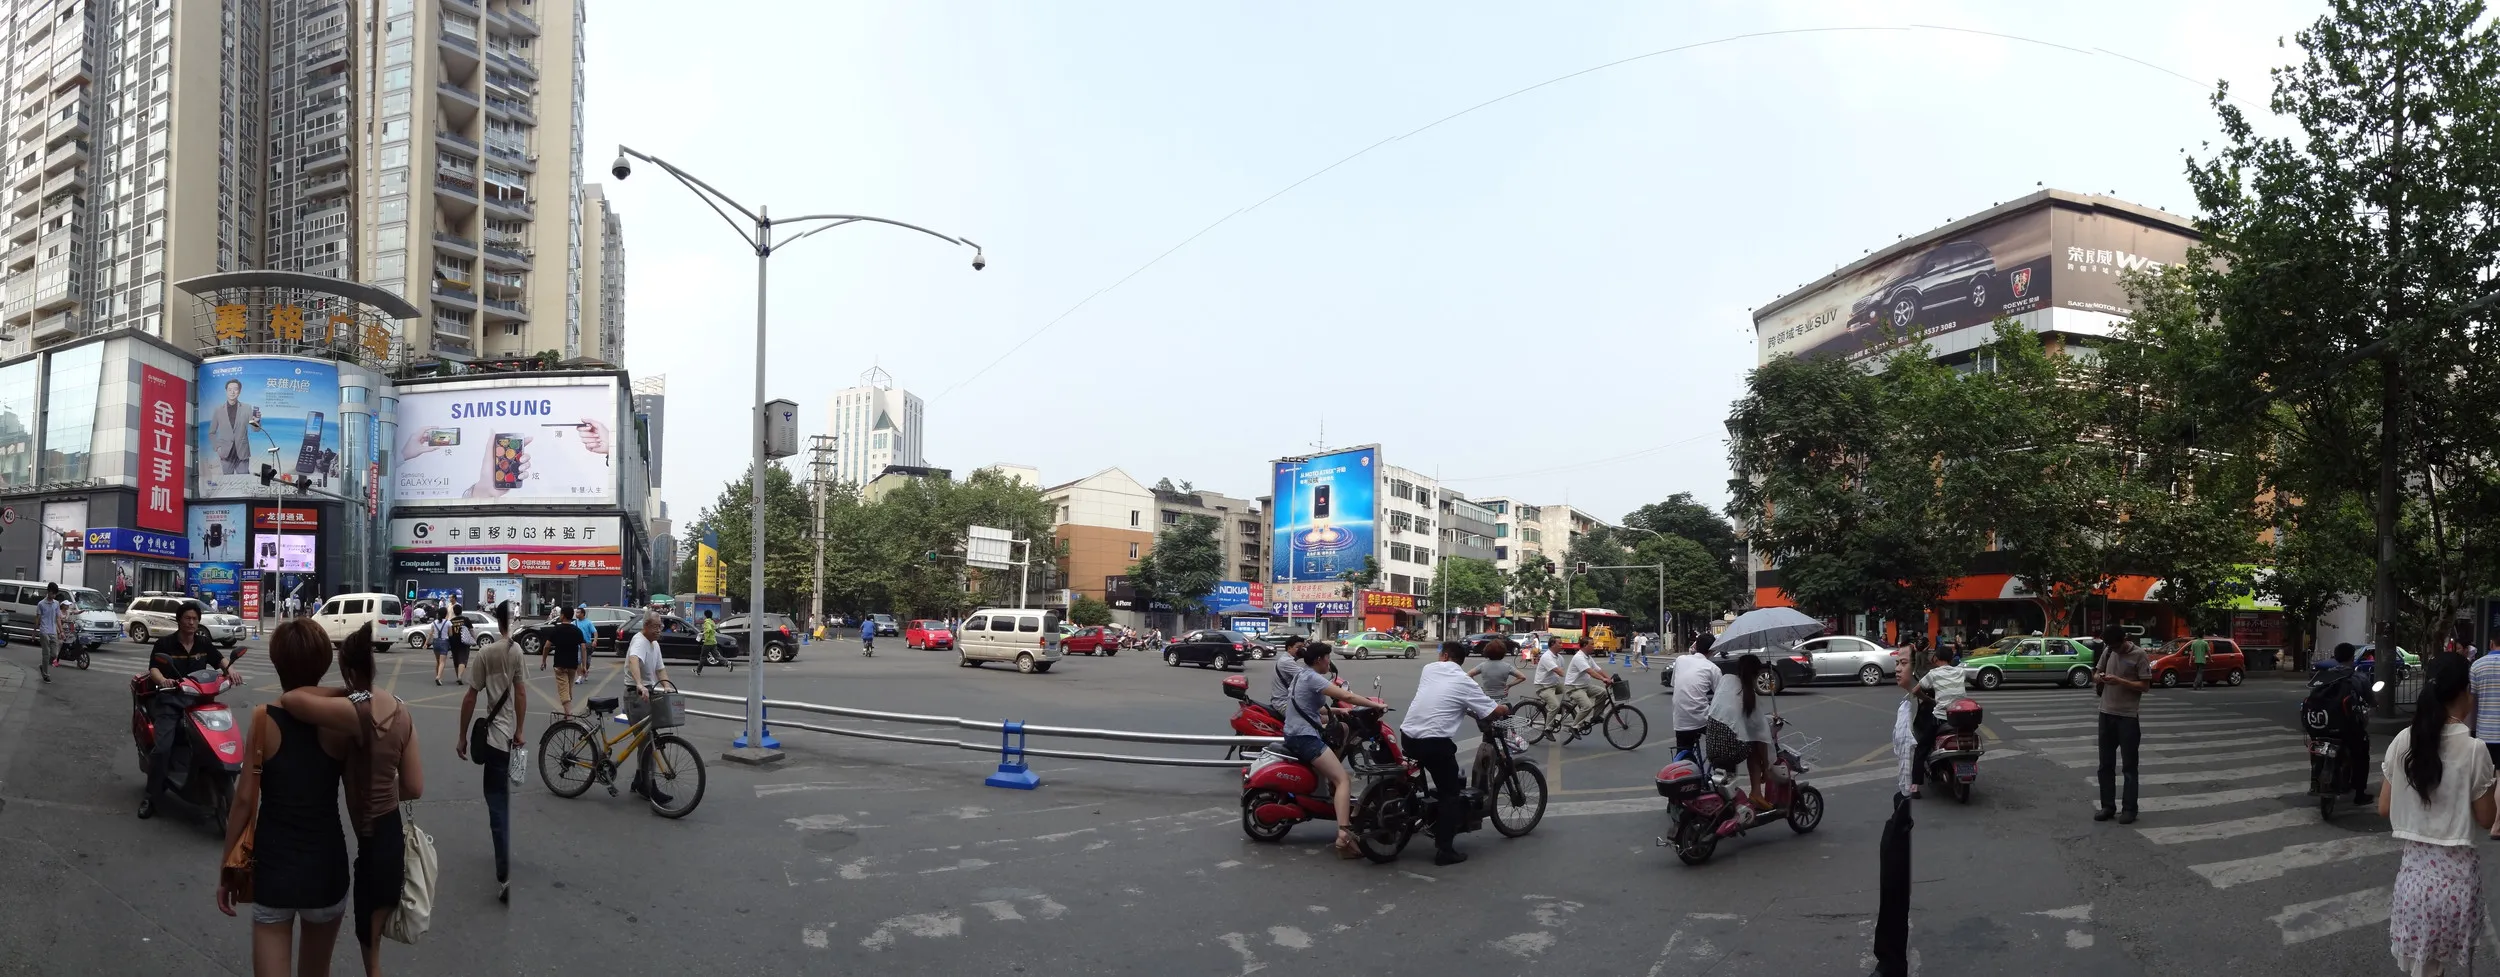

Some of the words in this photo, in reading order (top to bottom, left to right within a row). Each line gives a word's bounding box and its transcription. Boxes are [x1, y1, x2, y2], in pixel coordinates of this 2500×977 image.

[2003, 299, 2028, 310] ROEWE
[1767, 309, 1838, 349] 跨领域专业SUV
[1940, 321, 1957, 331] 3083
[266, 378, 311, 392] 英雄本色
[451, 399, 551, 419] SAMSUNG
[150, 399, 175, 514] 金立手机
[445, 448, 452, 456] 快
[532, 472, 540, 480] 炫
[400, 478, 433, 487] GALAXY
[5, 511, 14, 520] 40
[147, 537, 176, 550] 中国电信
[453, 556, 501, 564] SAMSUNG
[568, 559, 606, 568] 龙翔通讯
[1220, 586, 1248, 595] NOKIA
[1327, 602, 1349, 610] 中国电信
